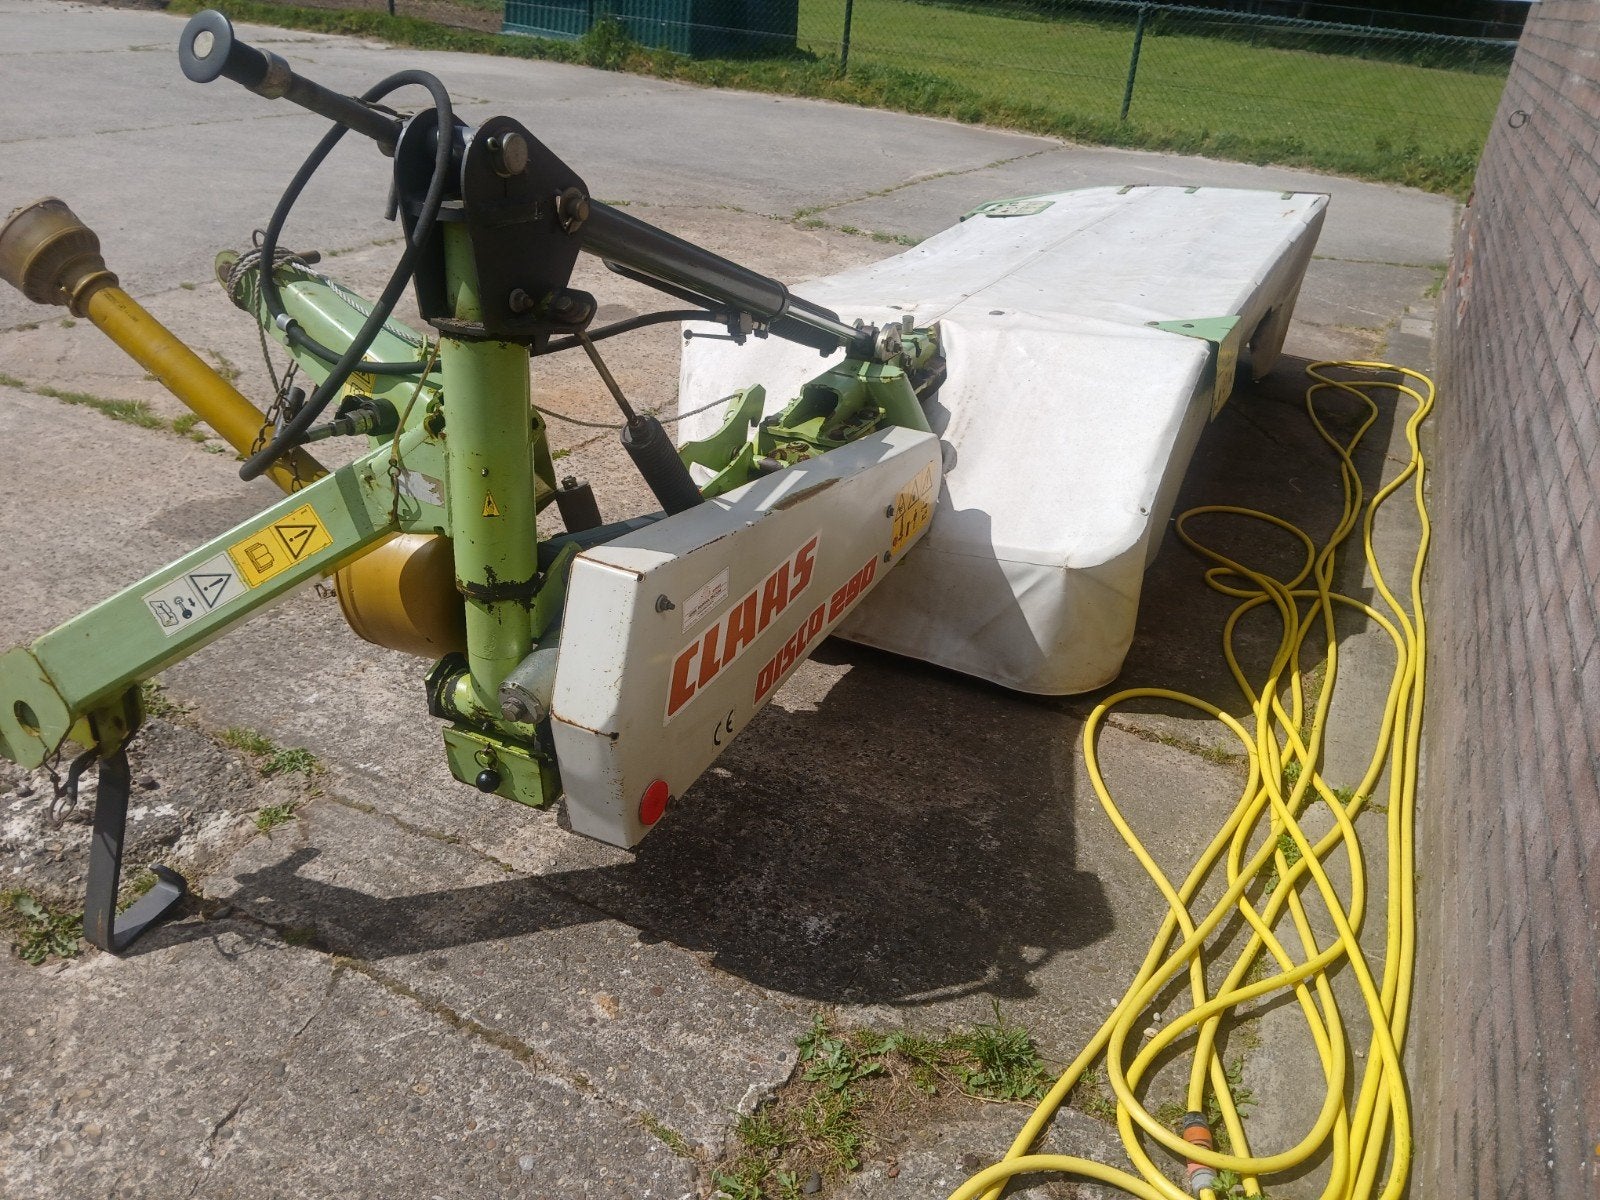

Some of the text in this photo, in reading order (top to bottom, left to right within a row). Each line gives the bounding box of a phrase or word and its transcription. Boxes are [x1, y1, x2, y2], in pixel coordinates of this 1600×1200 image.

[667, 536, 818, 717] CLAAS
[754, 555, 878, 704] DISCO 290
